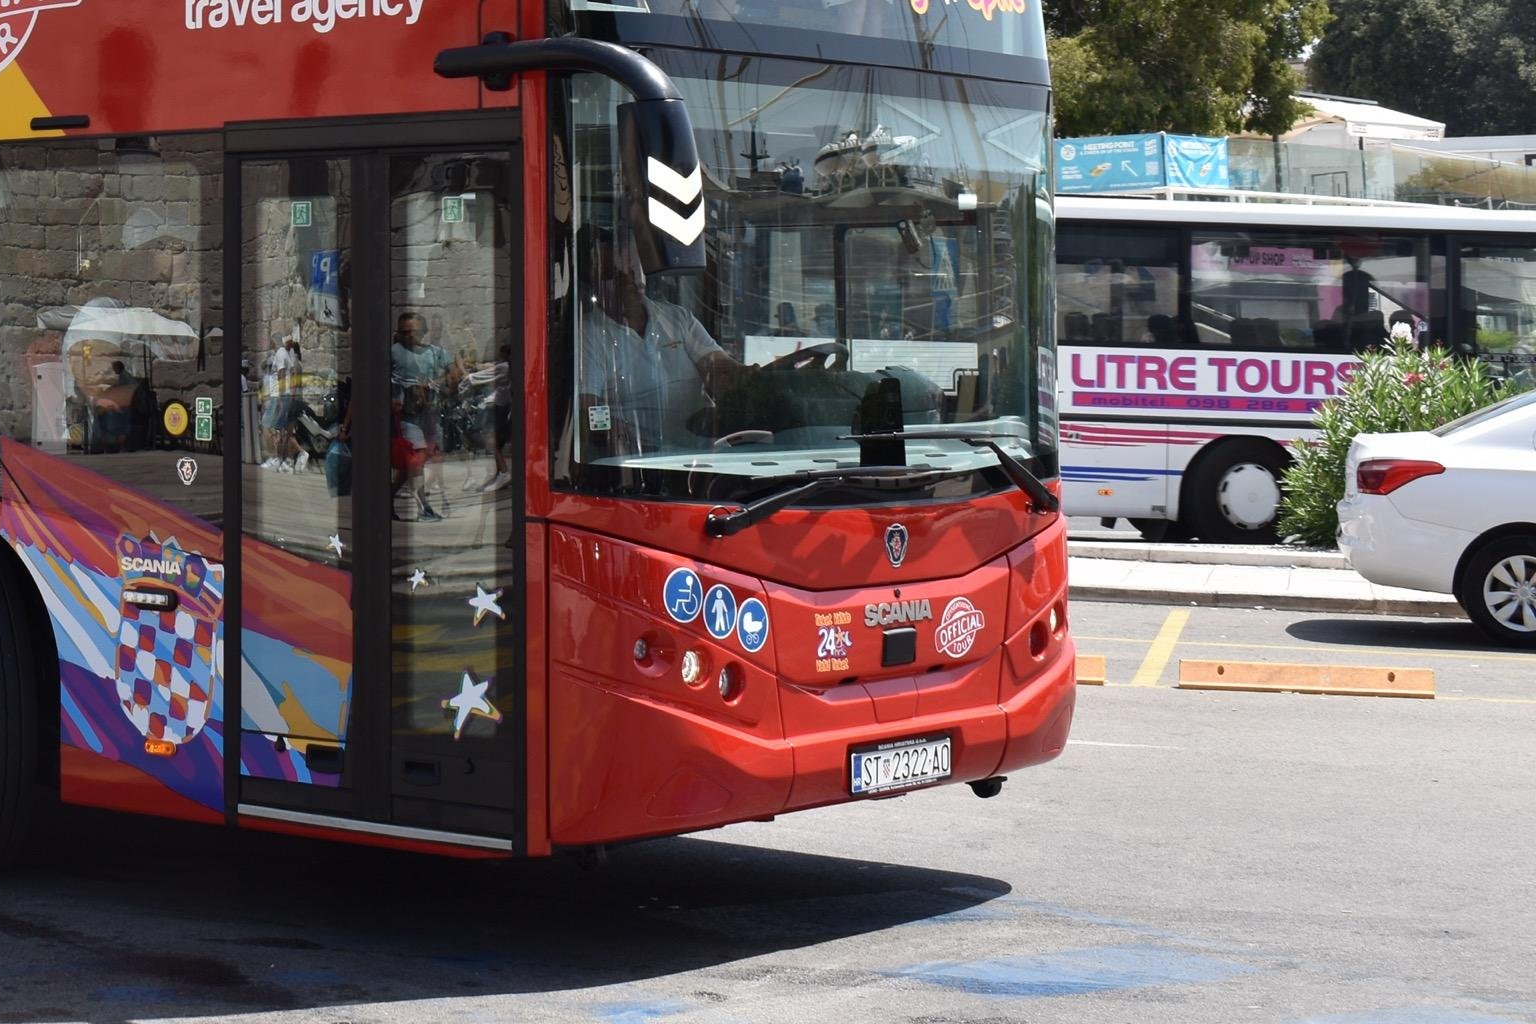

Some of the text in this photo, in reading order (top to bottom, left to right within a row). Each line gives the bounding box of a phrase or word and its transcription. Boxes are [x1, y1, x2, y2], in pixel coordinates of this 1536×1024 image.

[1072, 354, 1196, 391] LITRE
[121, 556, 181, 575] SCANIA
[864, 599, 932, 626] SCANIA
[818, 628, 835, 657] 24
[940, 614, 981, 645] OFFICIAL
[953, 635, 972, 653] TOUR
[864, 756, 881, 786] ST
